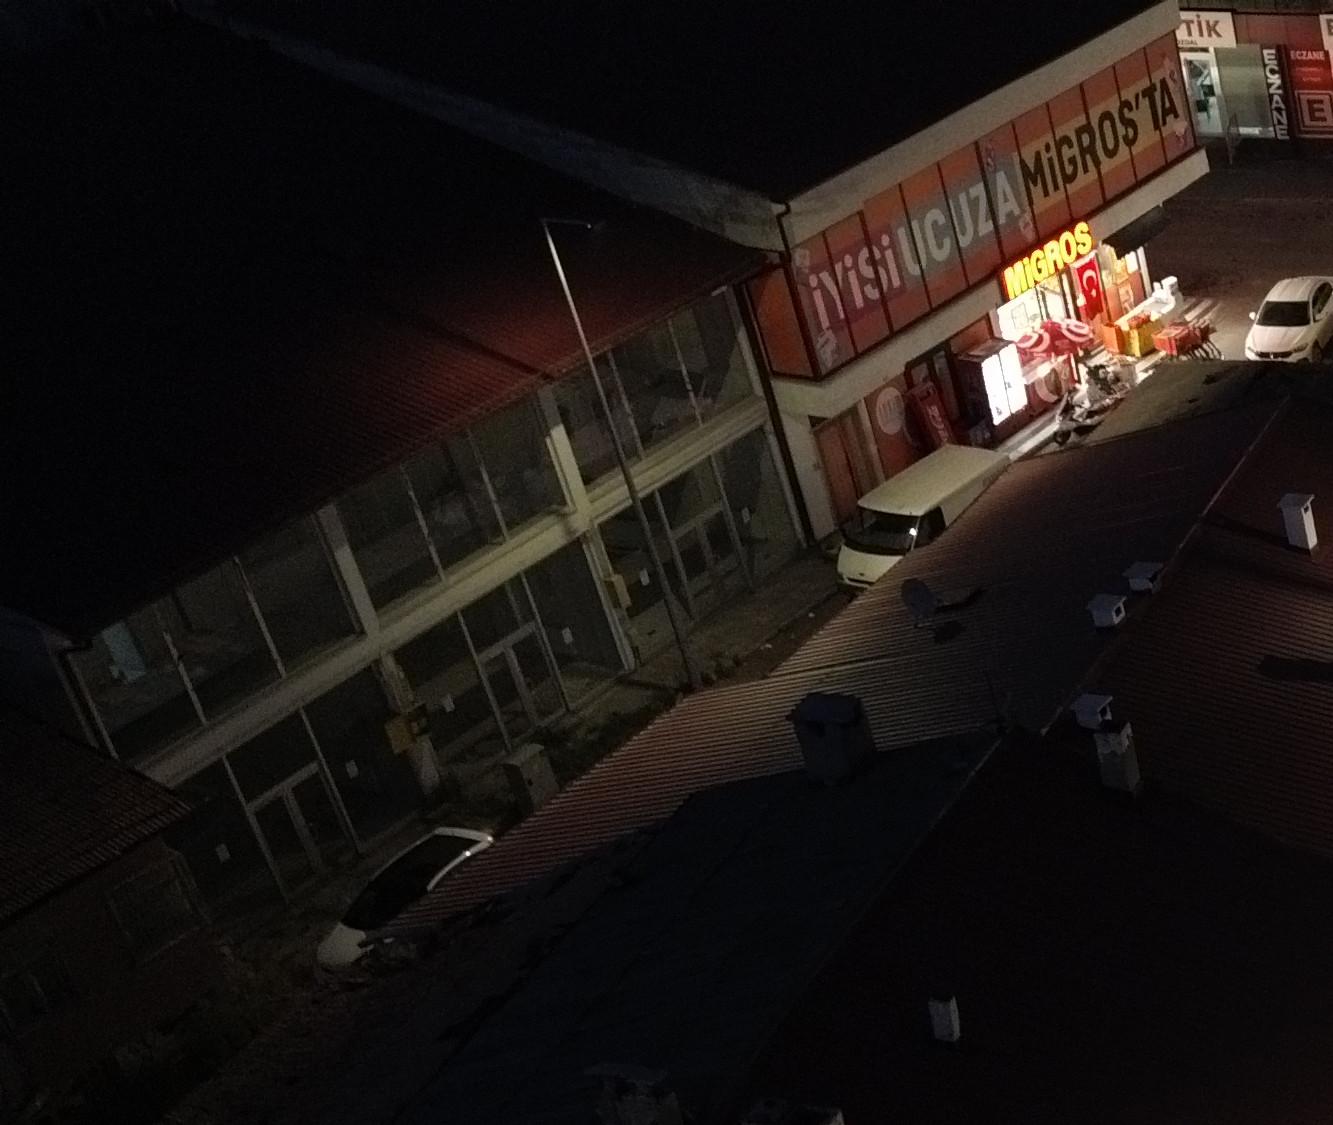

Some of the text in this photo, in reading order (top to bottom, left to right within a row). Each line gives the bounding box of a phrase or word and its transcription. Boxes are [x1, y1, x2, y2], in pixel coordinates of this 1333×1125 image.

[1177, 14, 1222, 38] TİK
[1290, 51, 1325, 61] ECZANE
[1263, 49, 1290, 140] ECZANE
[897, 170, 1020, 275] UCUZA
